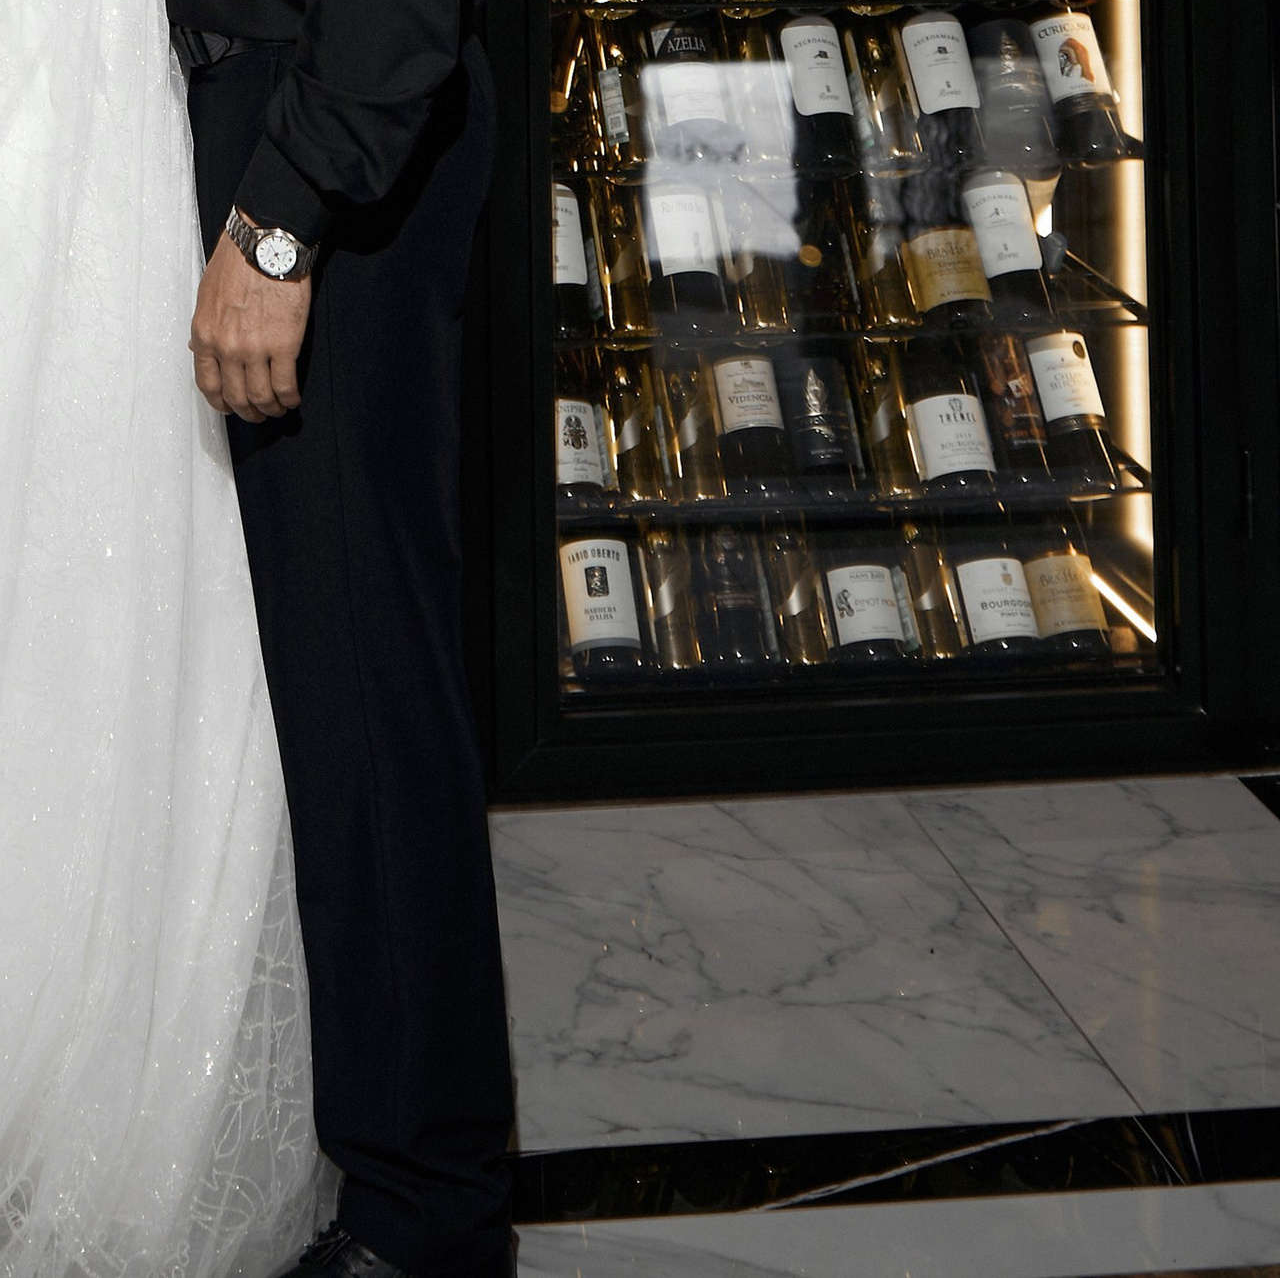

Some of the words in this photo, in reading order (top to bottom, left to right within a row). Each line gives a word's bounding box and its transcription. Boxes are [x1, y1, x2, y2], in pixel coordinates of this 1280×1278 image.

[667, 36, 707, 53] AZELIA
[727, 394, 775, 406] VIDENCIA
[938, 412, 978, 425] TRENEL
[590, 547, 620, 562] OBERTO
